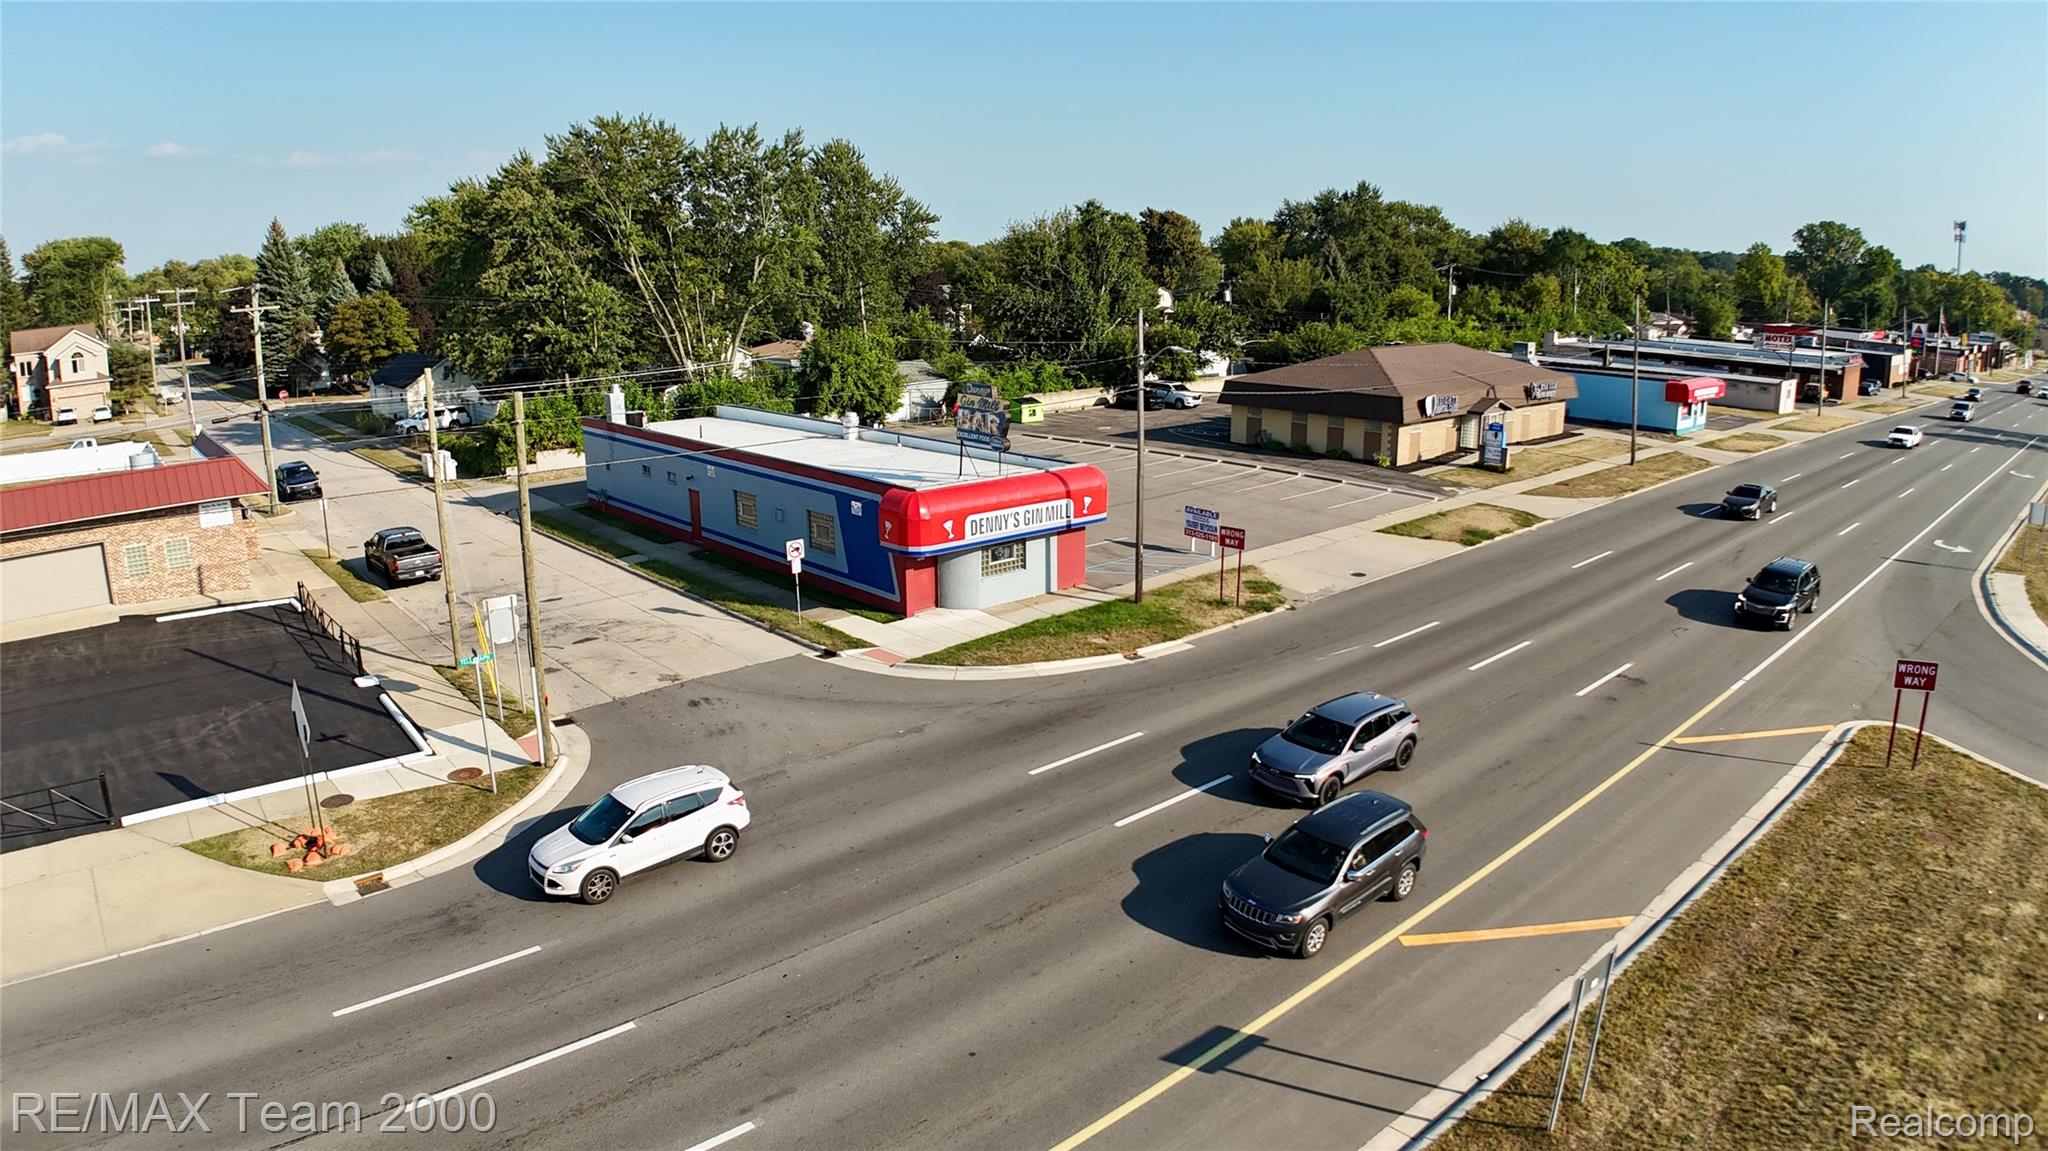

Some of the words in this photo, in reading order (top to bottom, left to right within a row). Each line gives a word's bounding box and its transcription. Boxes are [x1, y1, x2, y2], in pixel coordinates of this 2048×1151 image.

[960, 395, 976, 407] Gin
[978, 398, 1001, 412] Mill
[957, 408, 1000, 435] BAR
[970, 511, 1020, 536] DENNY'S
[1023, 507, 1043, 527] GIN
[1045, 502, 1071, 522] MILL
[1186, 507, 1217, 519] AVAILABLE
[1221, 529, 1244, 538] WRONG
[1225, 538, 1239, 546] WAY
[1898, 663, 1936, 675] WRONG
[1904, 676, 1927, 686] WAY
